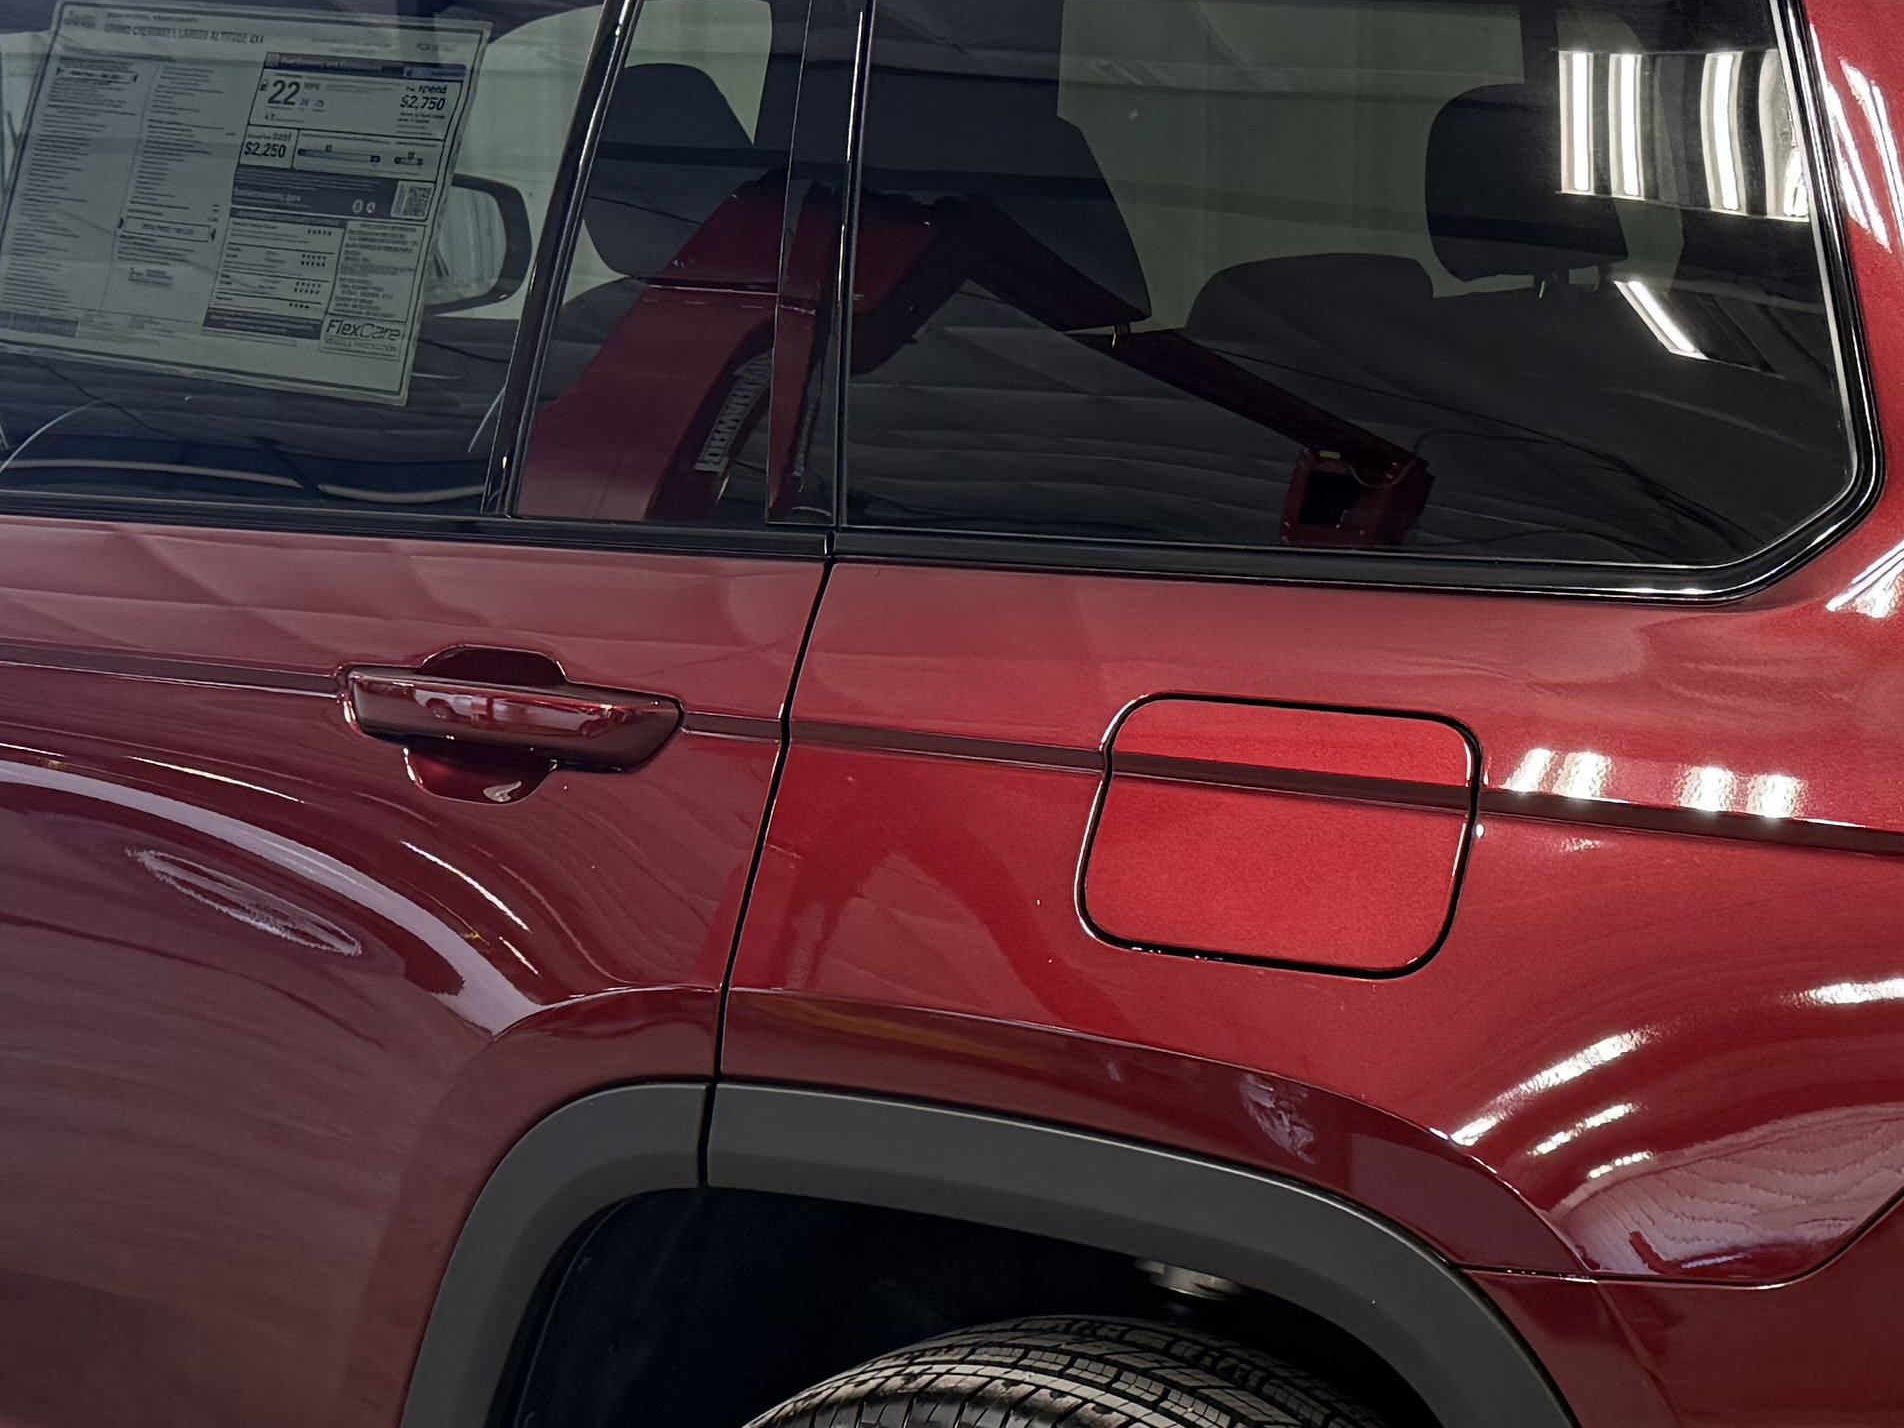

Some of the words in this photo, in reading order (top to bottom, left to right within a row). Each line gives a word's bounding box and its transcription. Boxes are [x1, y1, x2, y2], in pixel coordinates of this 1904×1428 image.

[267, 79, 301, 105] 22
[399, 93, 446, 110] $2,750
[325, 319, 401, 341] FlexCare
